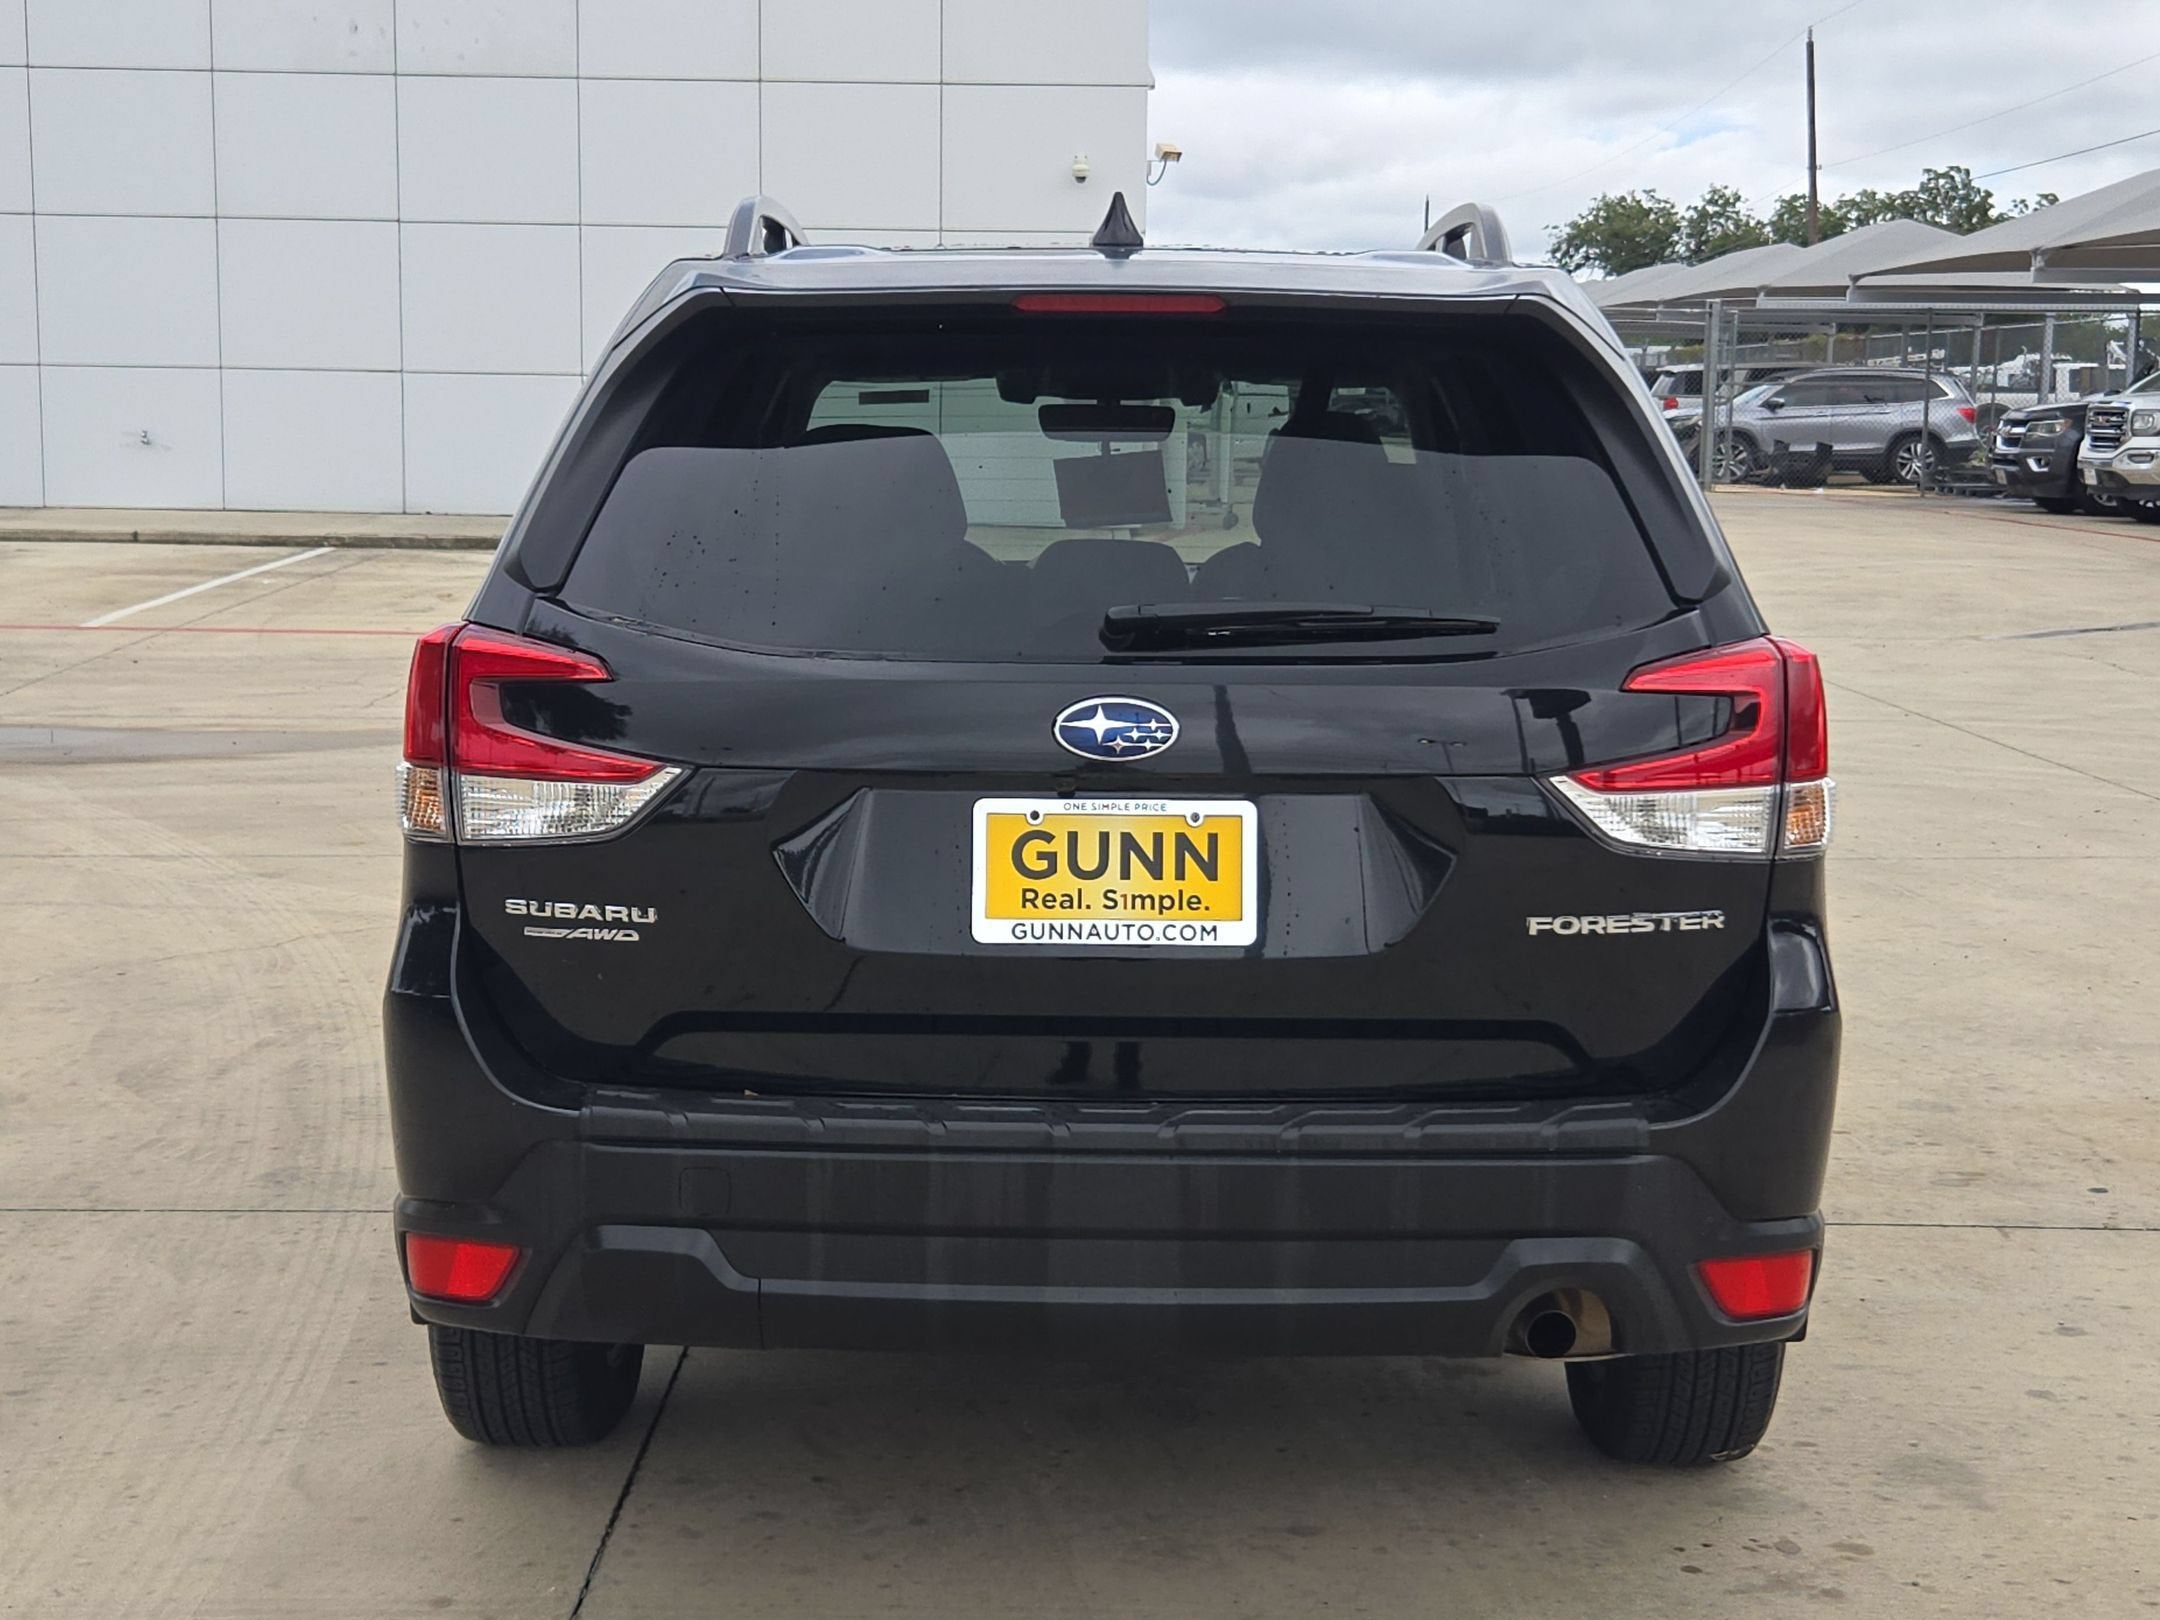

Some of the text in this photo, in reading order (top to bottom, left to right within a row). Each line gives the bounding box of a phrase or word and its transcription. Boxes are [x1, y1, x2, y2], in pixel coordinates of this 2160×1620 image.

[1063, 802, 1167, 812] ONE SIMPLE PRICE
[1011, 829, 1219, 882] GUNN
[1021, 887, 1091, 910] Real.
[504, 899, 657, 923] SUBARU
[1526, 909, 1725, 936] FORESTER
[566, 927, 640, 941] AWD
[1011, 922, 1218, 941] GUNNAUTO.COM
